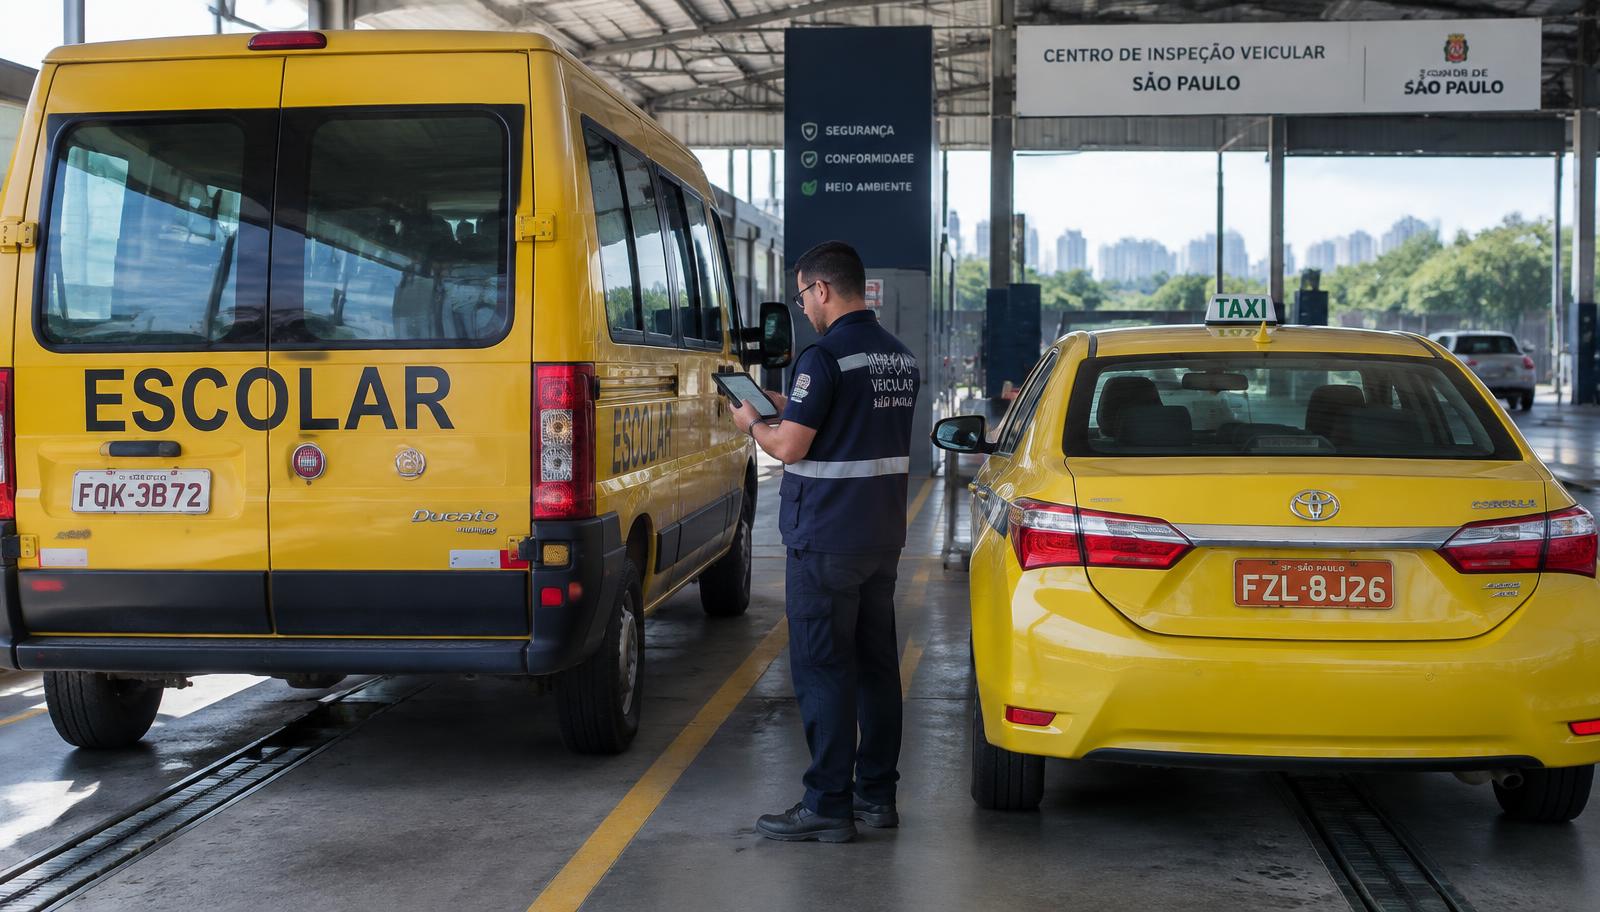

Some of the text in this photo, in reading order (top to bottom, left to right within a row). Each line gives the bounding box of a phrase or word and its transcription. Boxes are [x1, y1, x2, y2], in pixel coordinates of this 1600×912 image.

[1043, 42, 1326, 64] CENTRO DE INSPEÇÃO VEICULAR
[1131, 71, 1241, 91] SÃO PAULO
[1445, 80, 1505, 95] PAULO
[825, 125, 895, 138] SEGURANÇA
[856, 181, 913, 192] AMBIENTE
[1215, 298, 1267, 319] TAXI
[84, 365, 455, 433] ESCOLAR
[78, 482, 203, 510] FQK-3B72
[411, 509, 500, 523] Ducato
[1316, 564, 1346, 573] PAULO
[1242, 574, 1387, 604] FZL-8J26
